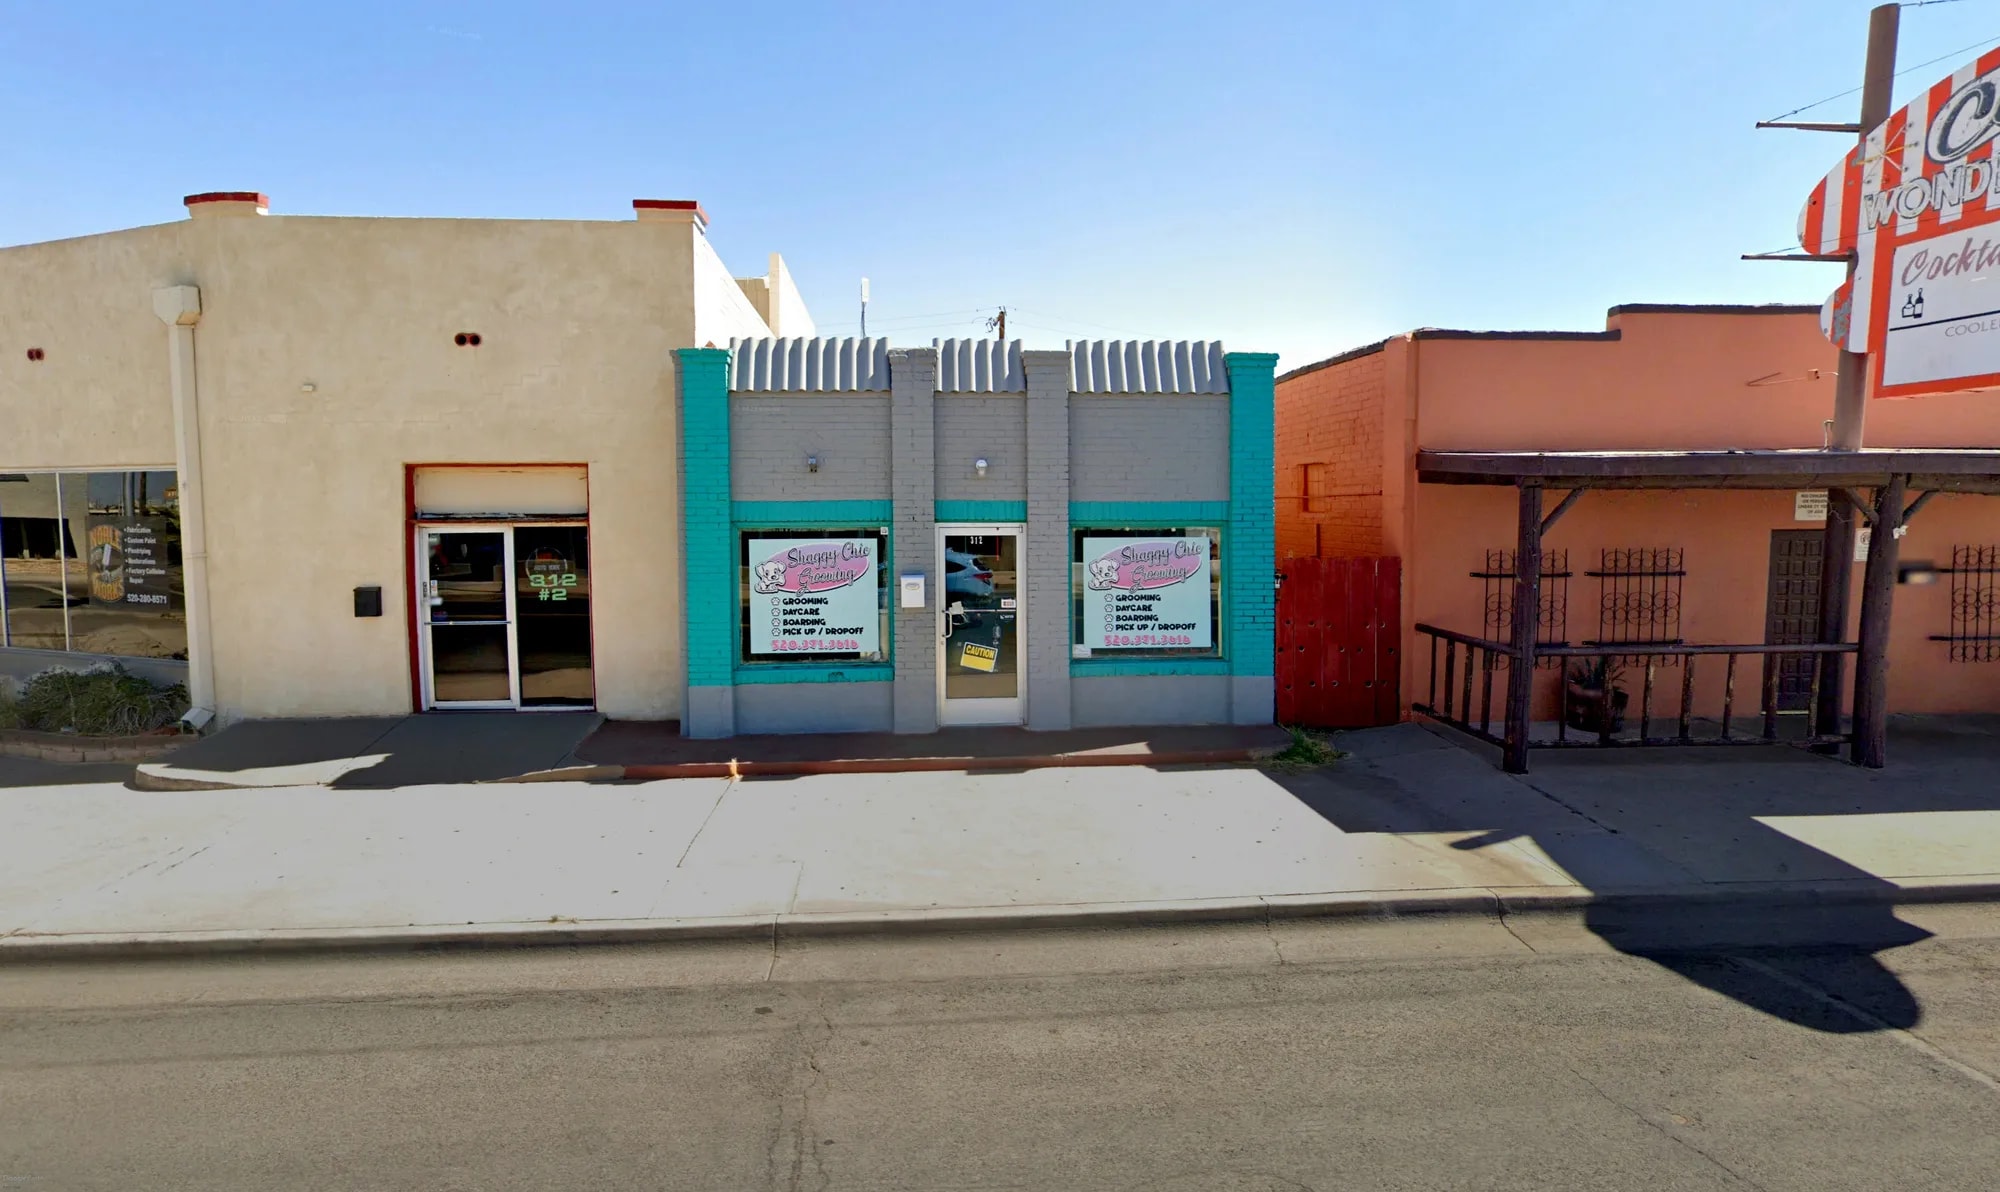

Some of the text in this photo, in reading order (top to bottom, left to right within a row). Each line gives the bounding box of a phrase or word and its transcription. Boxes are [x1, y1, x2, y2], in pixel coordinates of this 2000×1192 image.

[1927, 66, 2000, 164] C
[1945, 318, 2000, 337] COOLE
[970, 536, 983, 544] 312
[787, 541, 871, 569] Shaggy Chic
[1120, 540, 1203, 567] Shaggy Chic
[530, 574, 577, 587] 312
[796, 567, 857, 597] Grooming
[1128, 564, 1189, 594] Grooming
[539, 588, 567, 600] #2
[1115, 594, 1161, 602] GROOMING
[782, 597, 828, 605] GROOMING
[782, 608, 820, 616] DAYCARE
[1115, 604, 1152, 612] DAYCARE
[782, 618, 826, 626] BOARDING
[1115, 614, 1159, 622] BOARDING
[825, 627, 863, 635] DROPOFF
[1115, 623, 1134, 631] PICK
[1137, 623, 1148, 631] UP
[1158, 622, 1196, 630] DROPOFF
[966, 645, 994, 658] CAUTION
